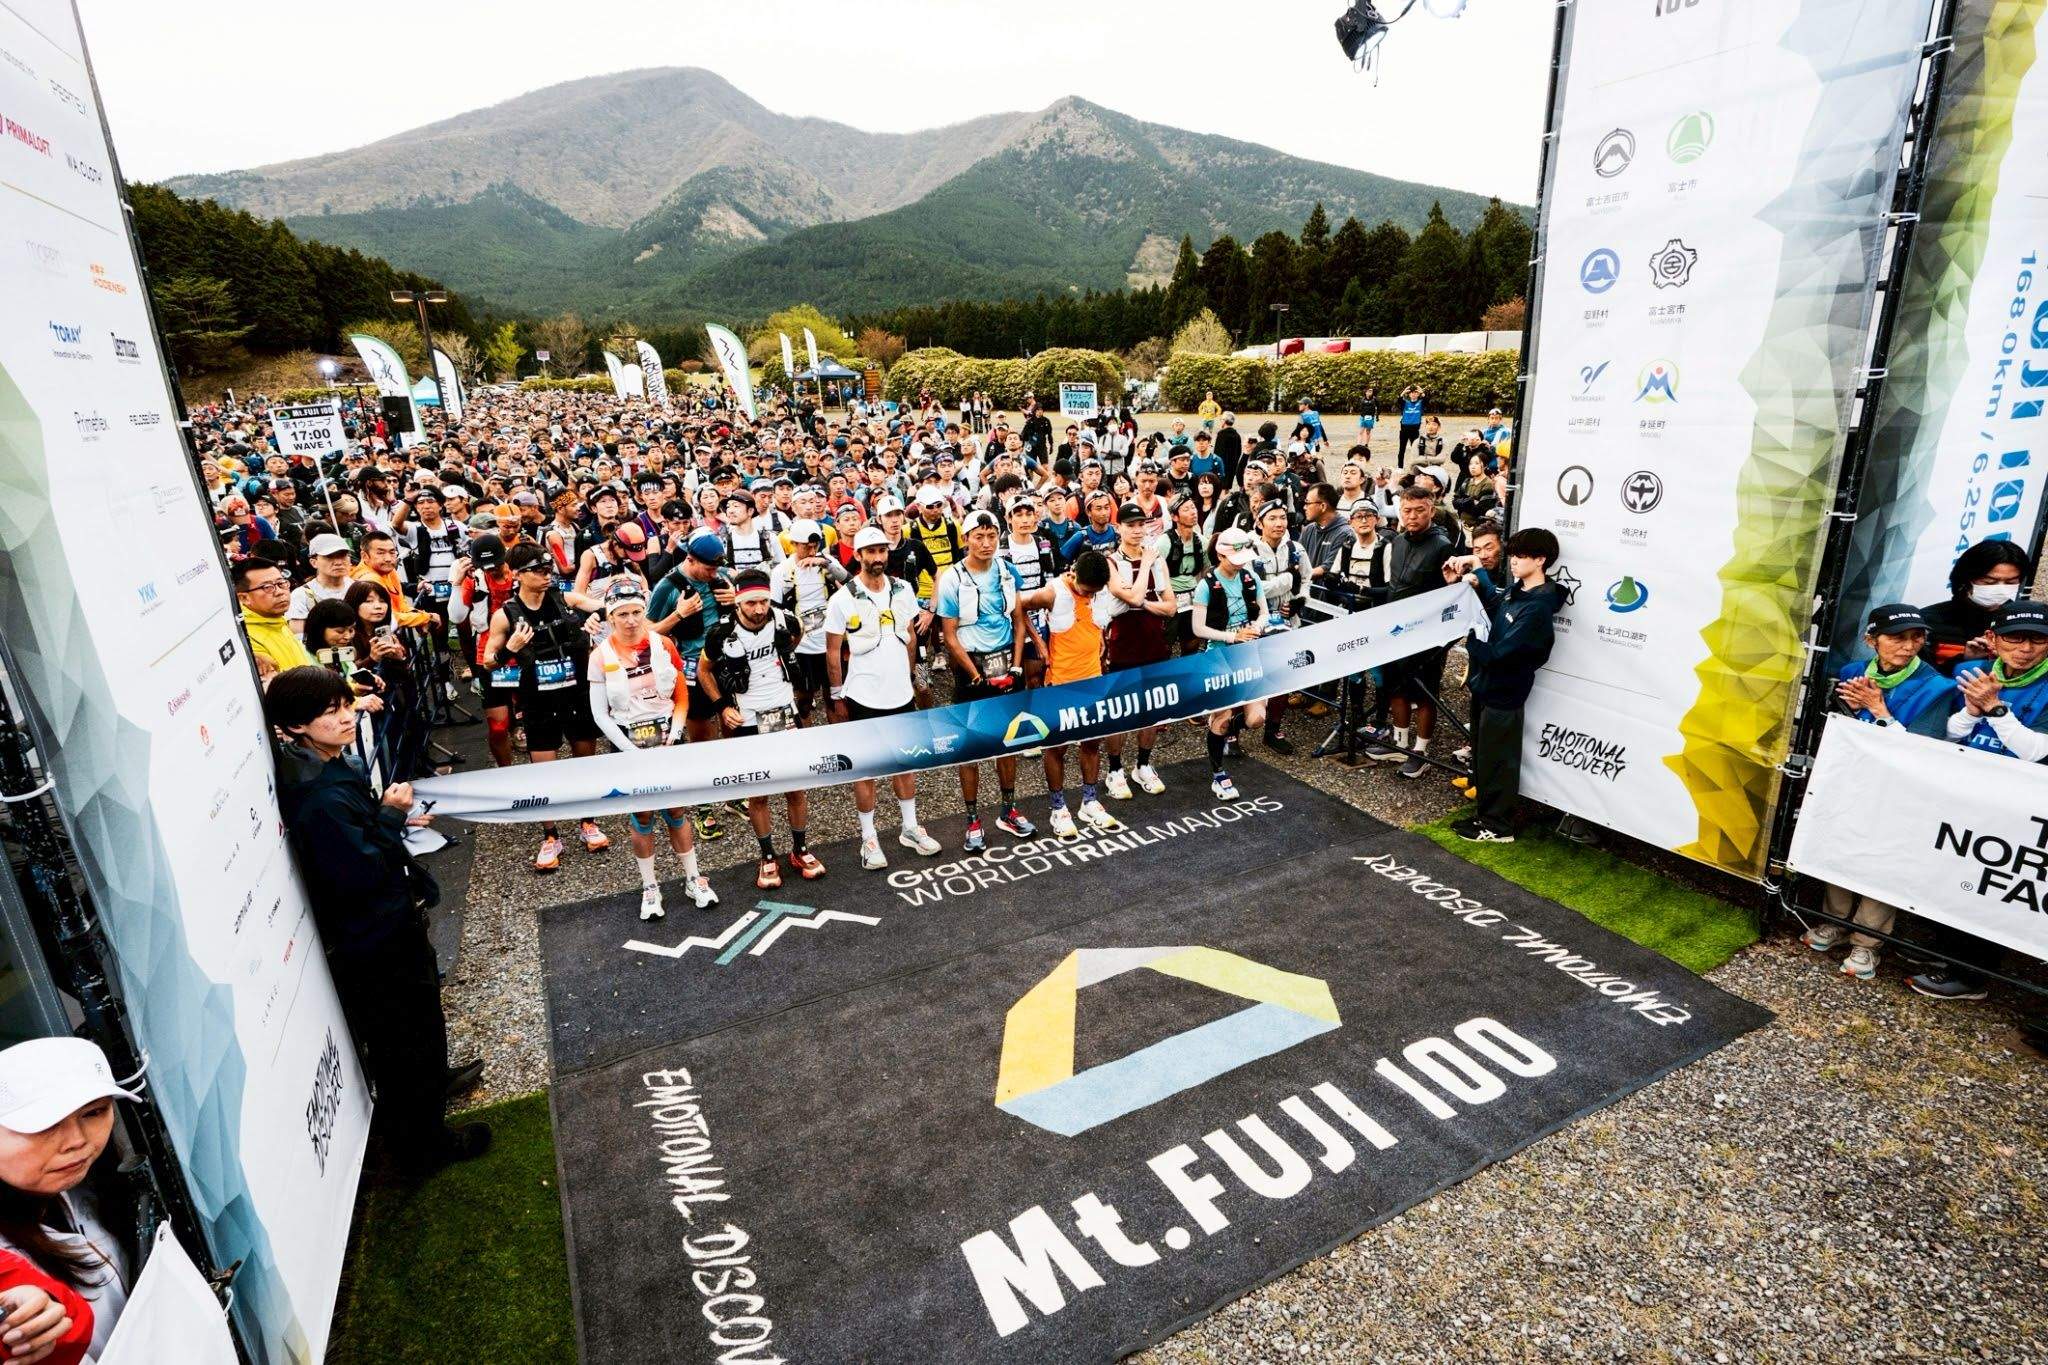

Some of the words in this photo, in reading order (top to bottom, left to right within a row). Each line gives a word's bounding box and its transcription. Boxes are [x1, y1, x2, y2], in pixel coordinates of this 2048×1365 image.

[1648, 304, 1686, 317] 富士宮市
[1986, 250, 2037, 417] 168.0km
[1068, 401, 1090, 409] 17:00
[282, 418, 331, 430] 第1ウエーブ
[1640, 420, 1665, 430] 身延町
[290, 428, 331, 441] 17:00
[293, 441, 325, 451] WAVE
[327, 440, 333, 448] 1
[1987, 450, 2031, 542] 10
[1953, 453, 1989, 560] 6,254
[1597, 625, 1647, 643] 富士河口湖町
[1336, 636, 1369, 653] GORE-TEX
[988, 656, 1003, 669] 201
[1204, 675, 1230, 693] FUJI
[1058, 692, 1140, 732] Mt.FUJI
[1145, 683, 1180, 712] 100
[762, 712, 780, 725] 202
[634, 726, 656, 739] 302
[1541, 723, 1626, 764] EMOTIONAL
[809, 762, 838, 773] NORTH
[821, 755, 837, 763] THE
[1538, 739, 1626, 782] DISCOVERY
[712, 770, 771, 787] GORE-TEX
[511, 796, 549, 809] amino
[1352, 853, 1509, 928] DISCOVERY
[1977, 867, 2048, 914] FA
[1501, 924, 1692, 1028] EMOTIONAL
[306, 1026, 336, 1143] EMOTIONAL
[312, 1045, 343, 1178] DISCOVERY
[632, 1067, 732, 1225] EMOTIONAL
[960, 1081, 1397, 1338] Mt.FUJI
[1375, 1016, 1558, 1122] 100
